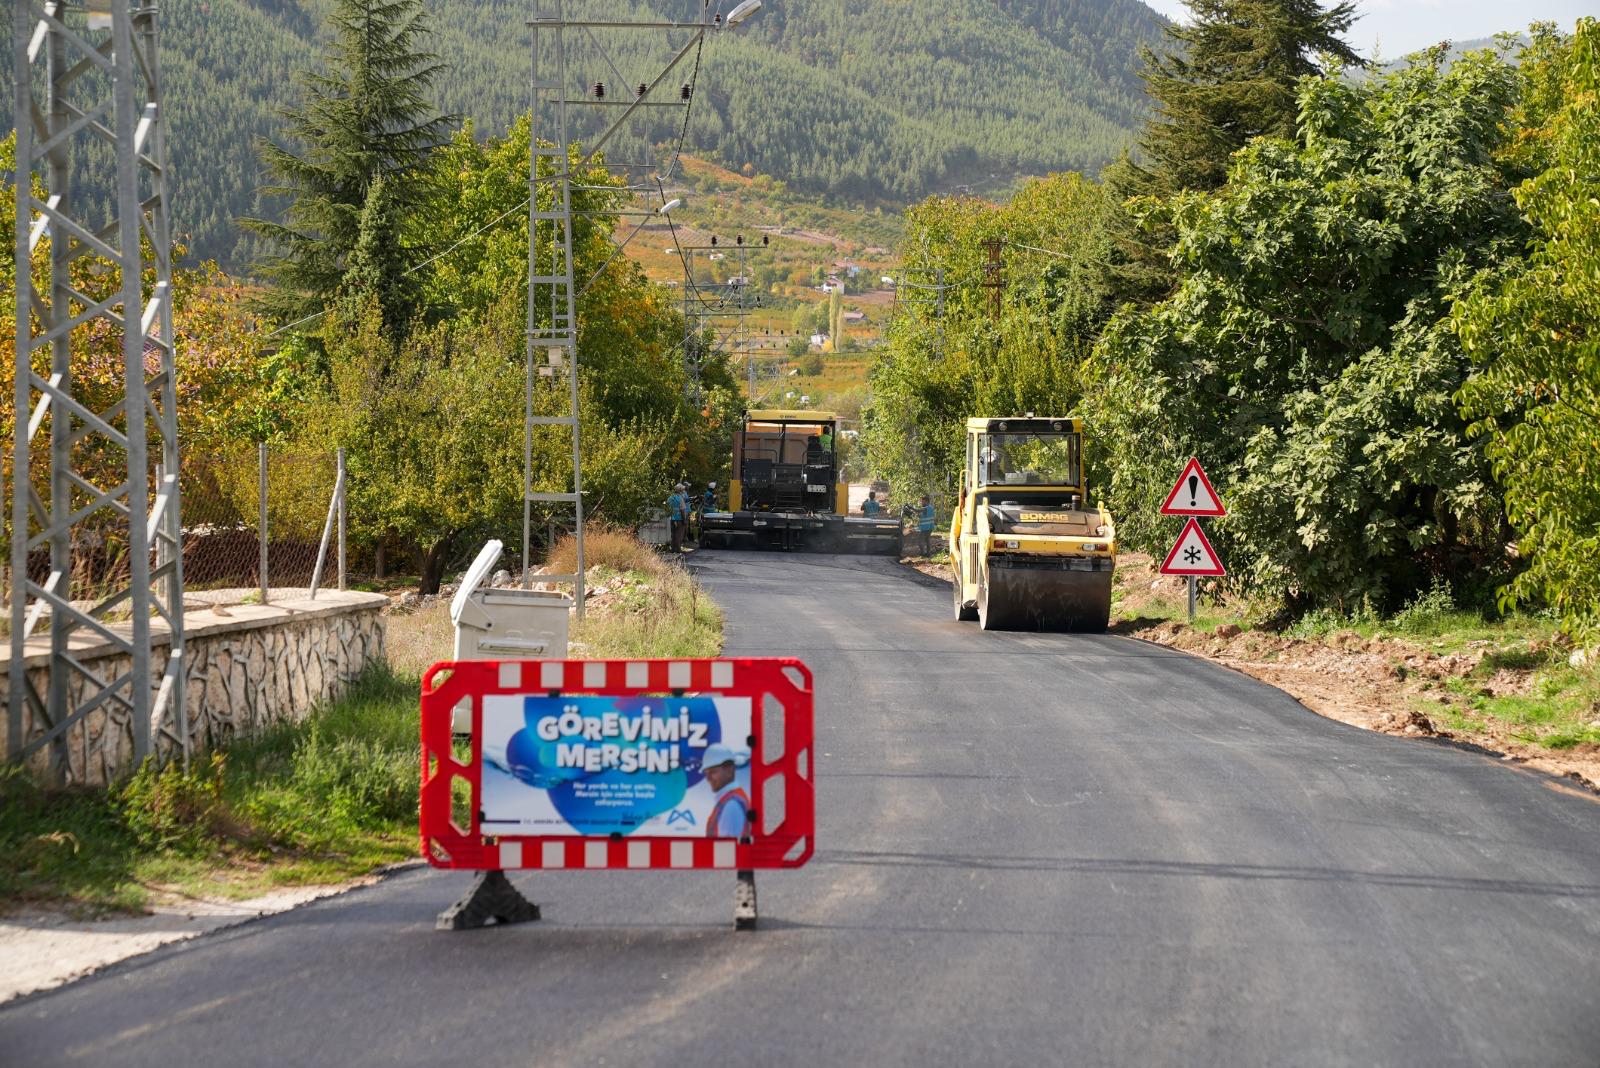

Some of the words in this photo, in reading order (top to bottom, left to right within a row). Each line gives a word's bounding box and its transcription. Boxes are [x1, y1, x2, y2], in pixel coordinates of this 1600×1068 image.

[1020, 513, 1068, 521] BOMAG
[537, 705, 708, 748] GÖREVİMİZ
[556, 741, 680, 773] MERSİN!
